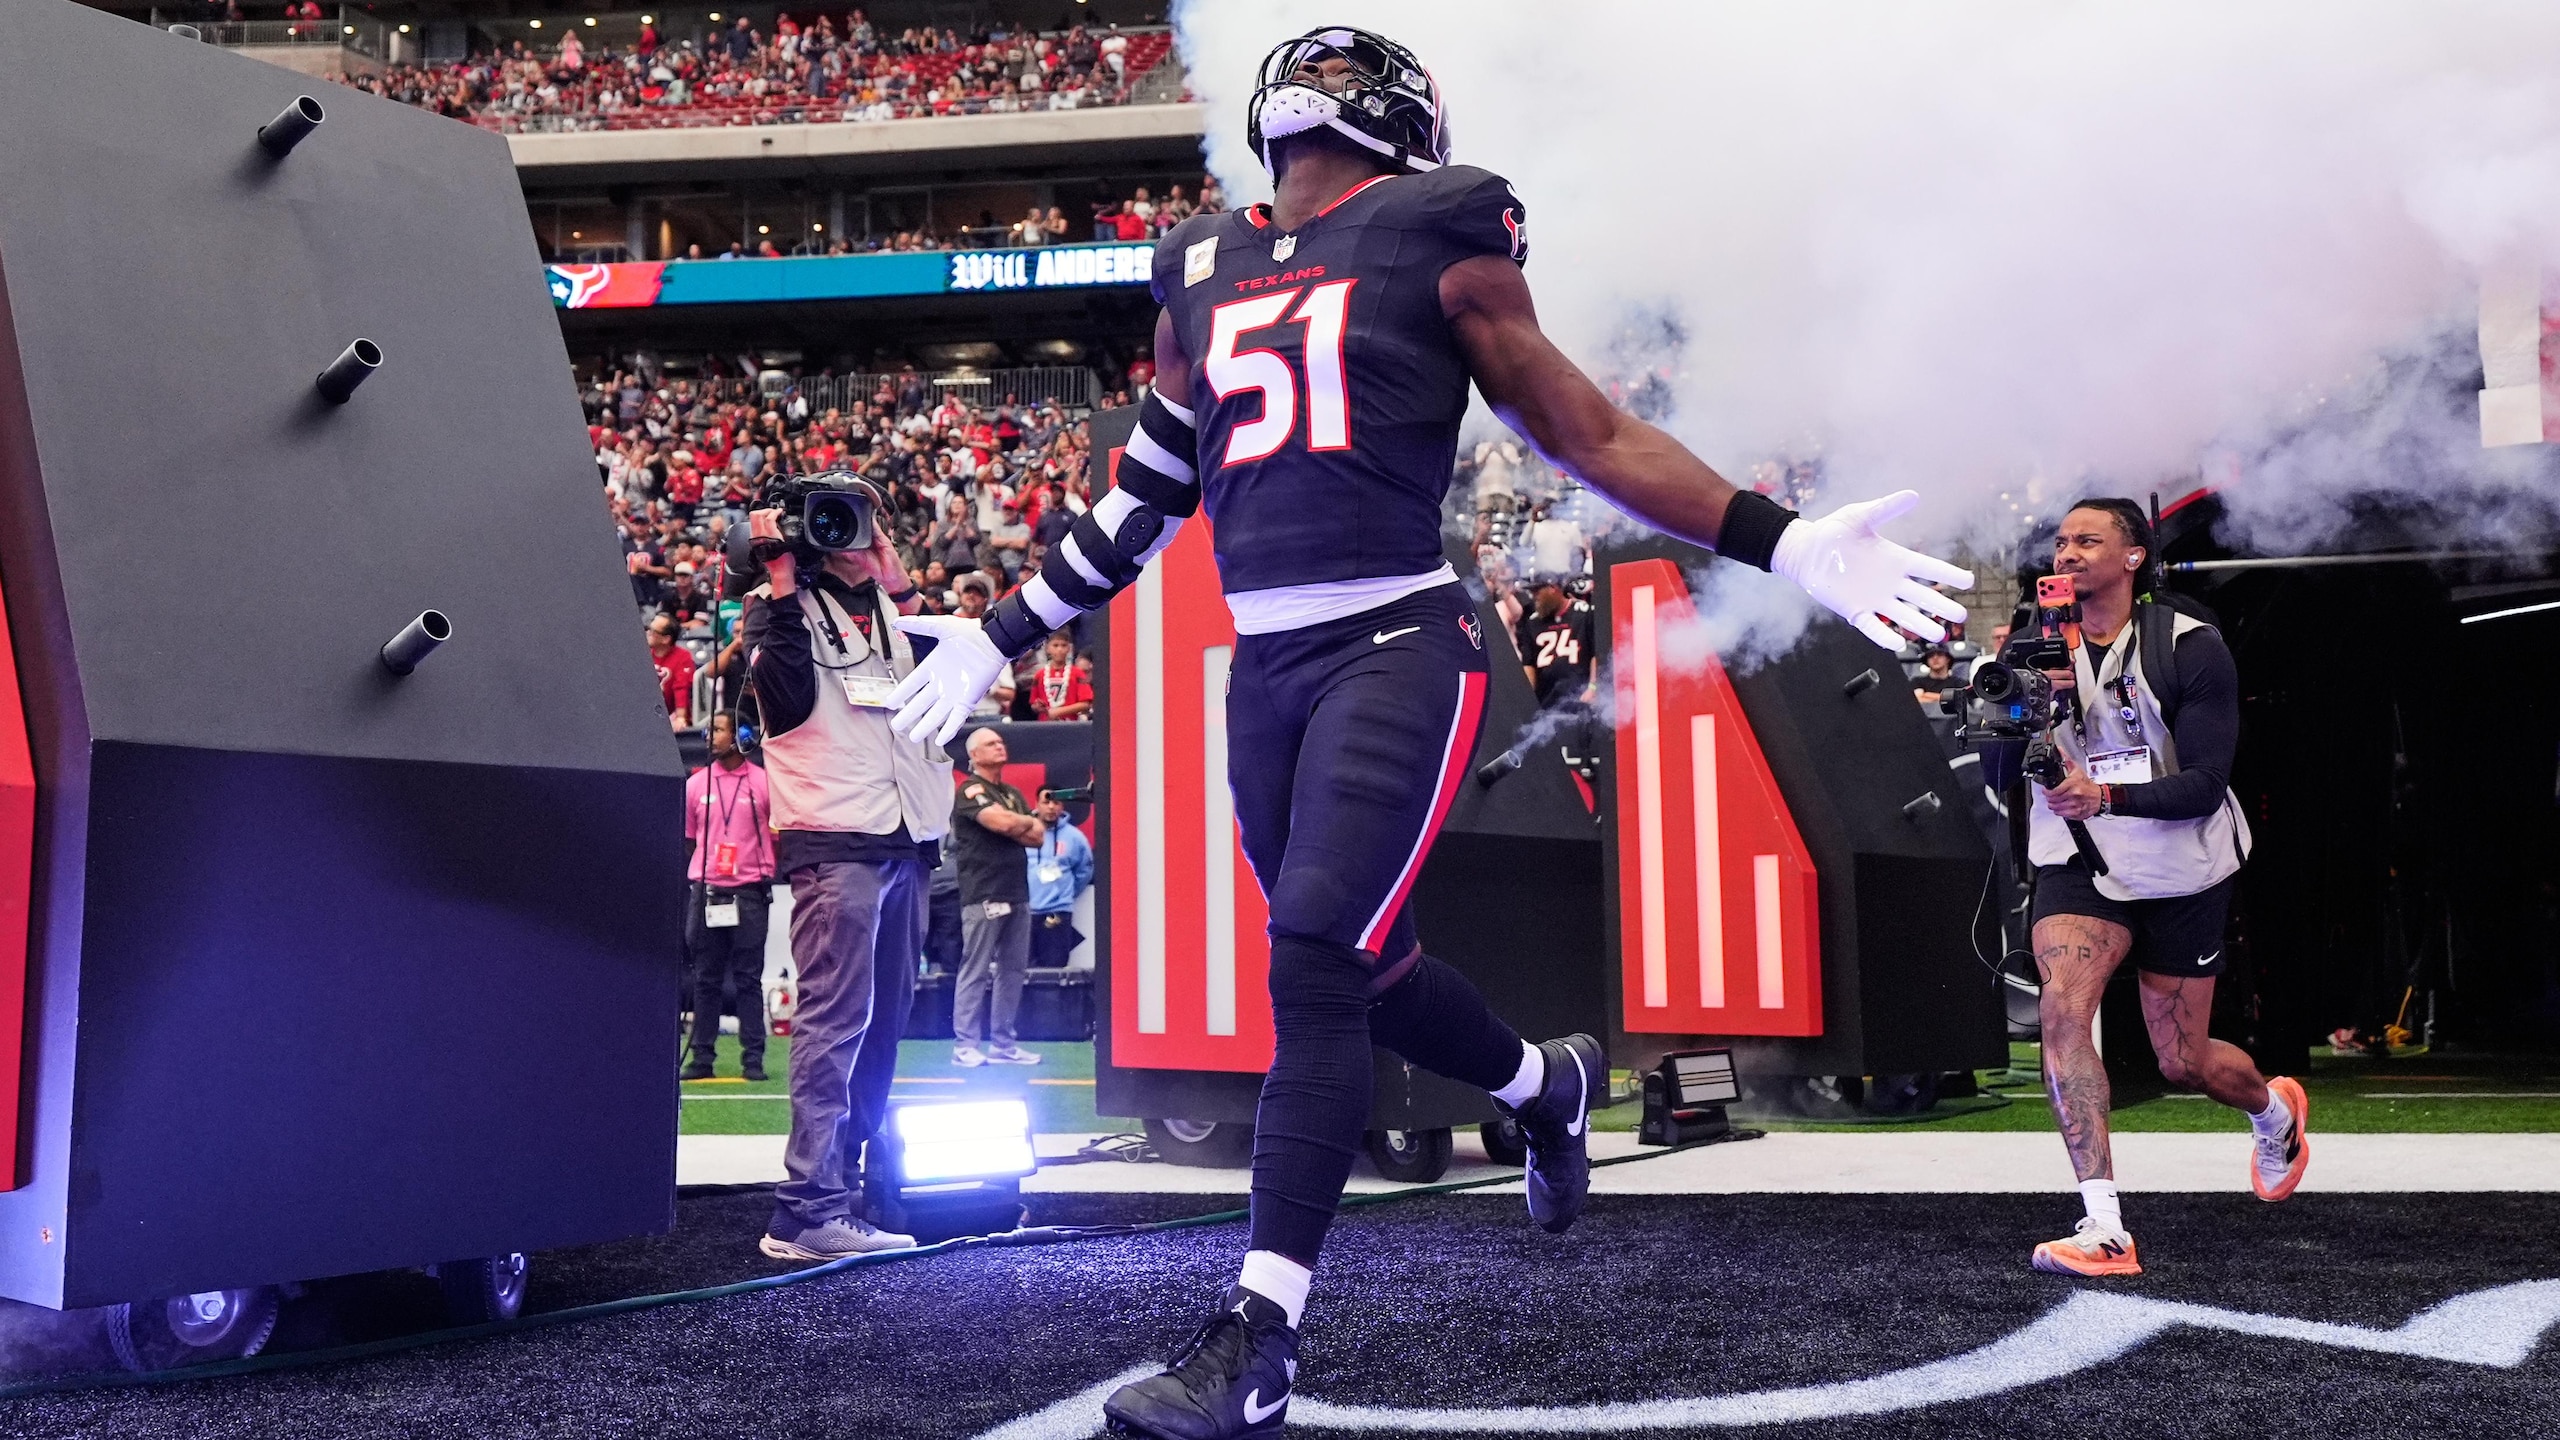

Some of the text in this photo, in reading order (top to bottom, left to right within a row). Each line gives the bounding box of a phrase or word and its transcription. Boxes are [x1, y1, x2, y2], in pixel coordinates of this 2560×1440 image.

[951, 246, 1154, 289] Will ANDERS
[1235, 265, 1326, 292] TEXANS
[1204, 278, 1359, 469] 51
[1536, 628, 1581, 668] 24
